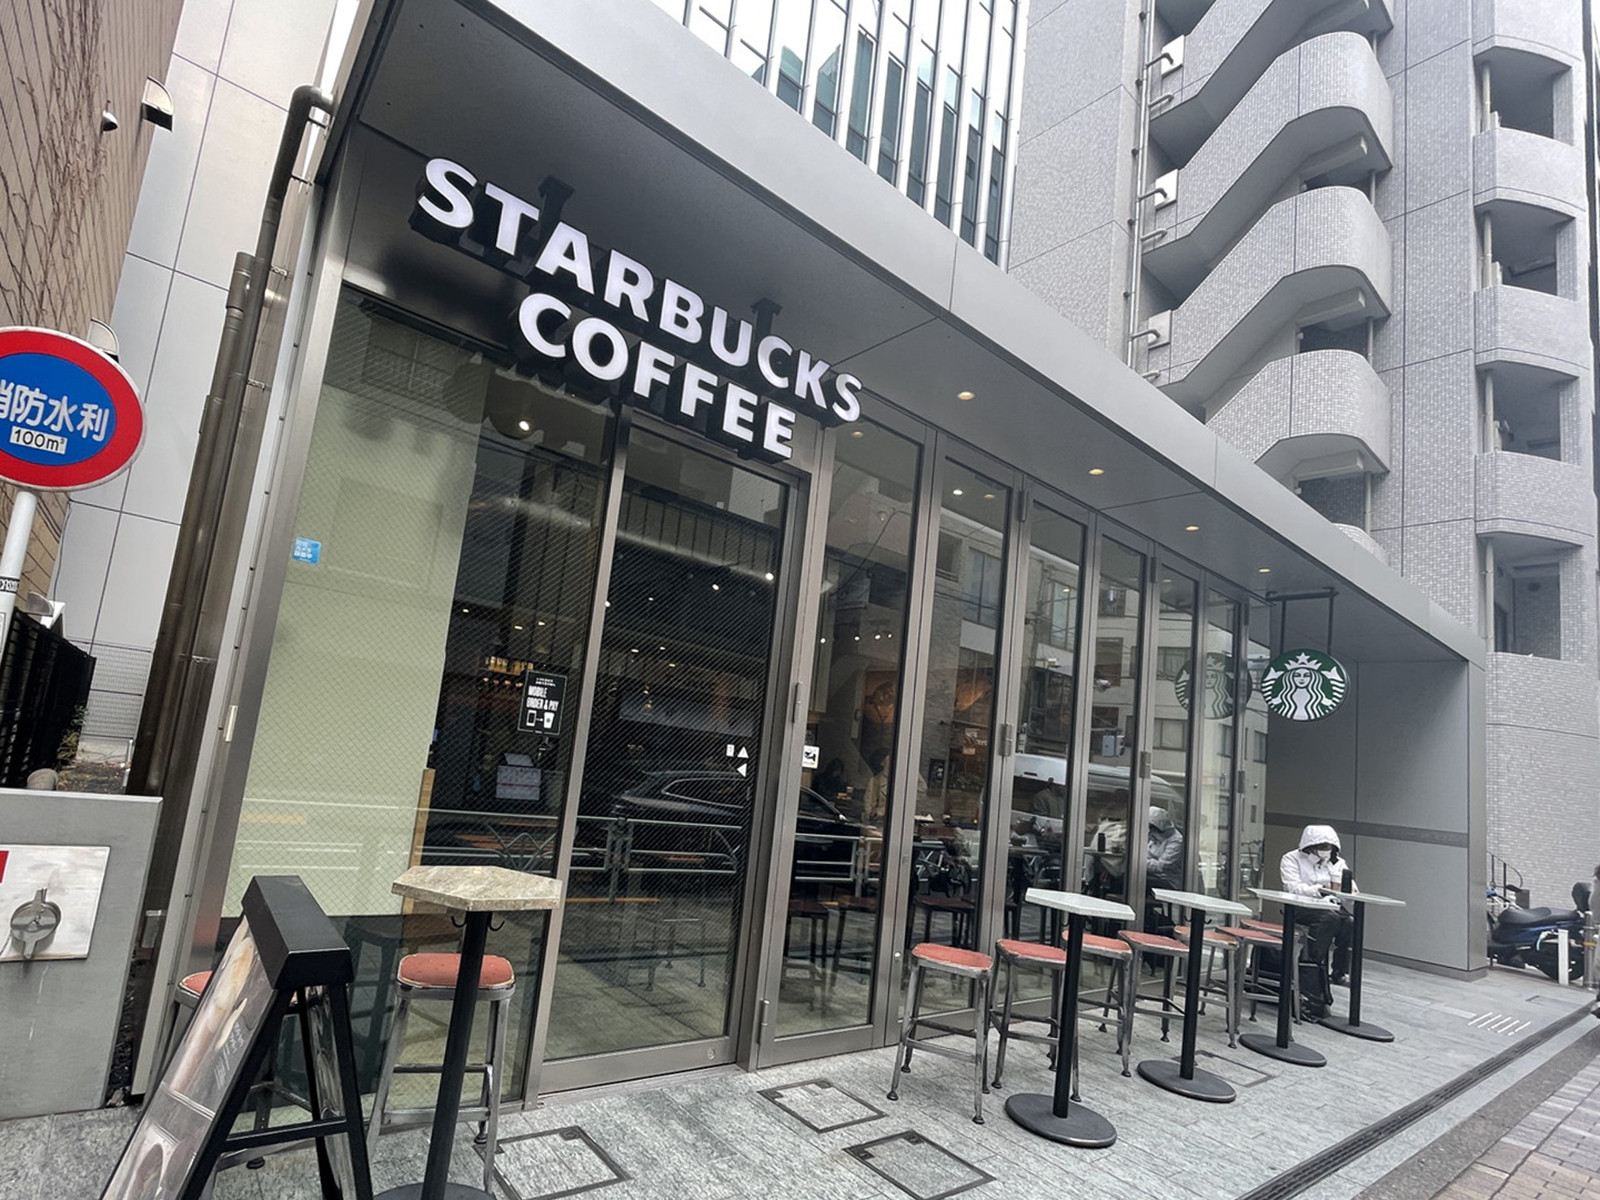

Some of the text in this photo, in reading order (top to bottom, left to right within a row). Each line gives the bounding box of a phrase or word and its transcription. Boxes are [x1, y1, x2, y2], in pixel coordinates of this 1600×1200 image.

[418, 157, 863, 423] STARBUCKS
[518, 292, 797, 460] COFFEE
[526, 697, 544, 709] ORDER
[548, 701, 559, 711] PAY
[528, 685, 547, 698] MOBILE
